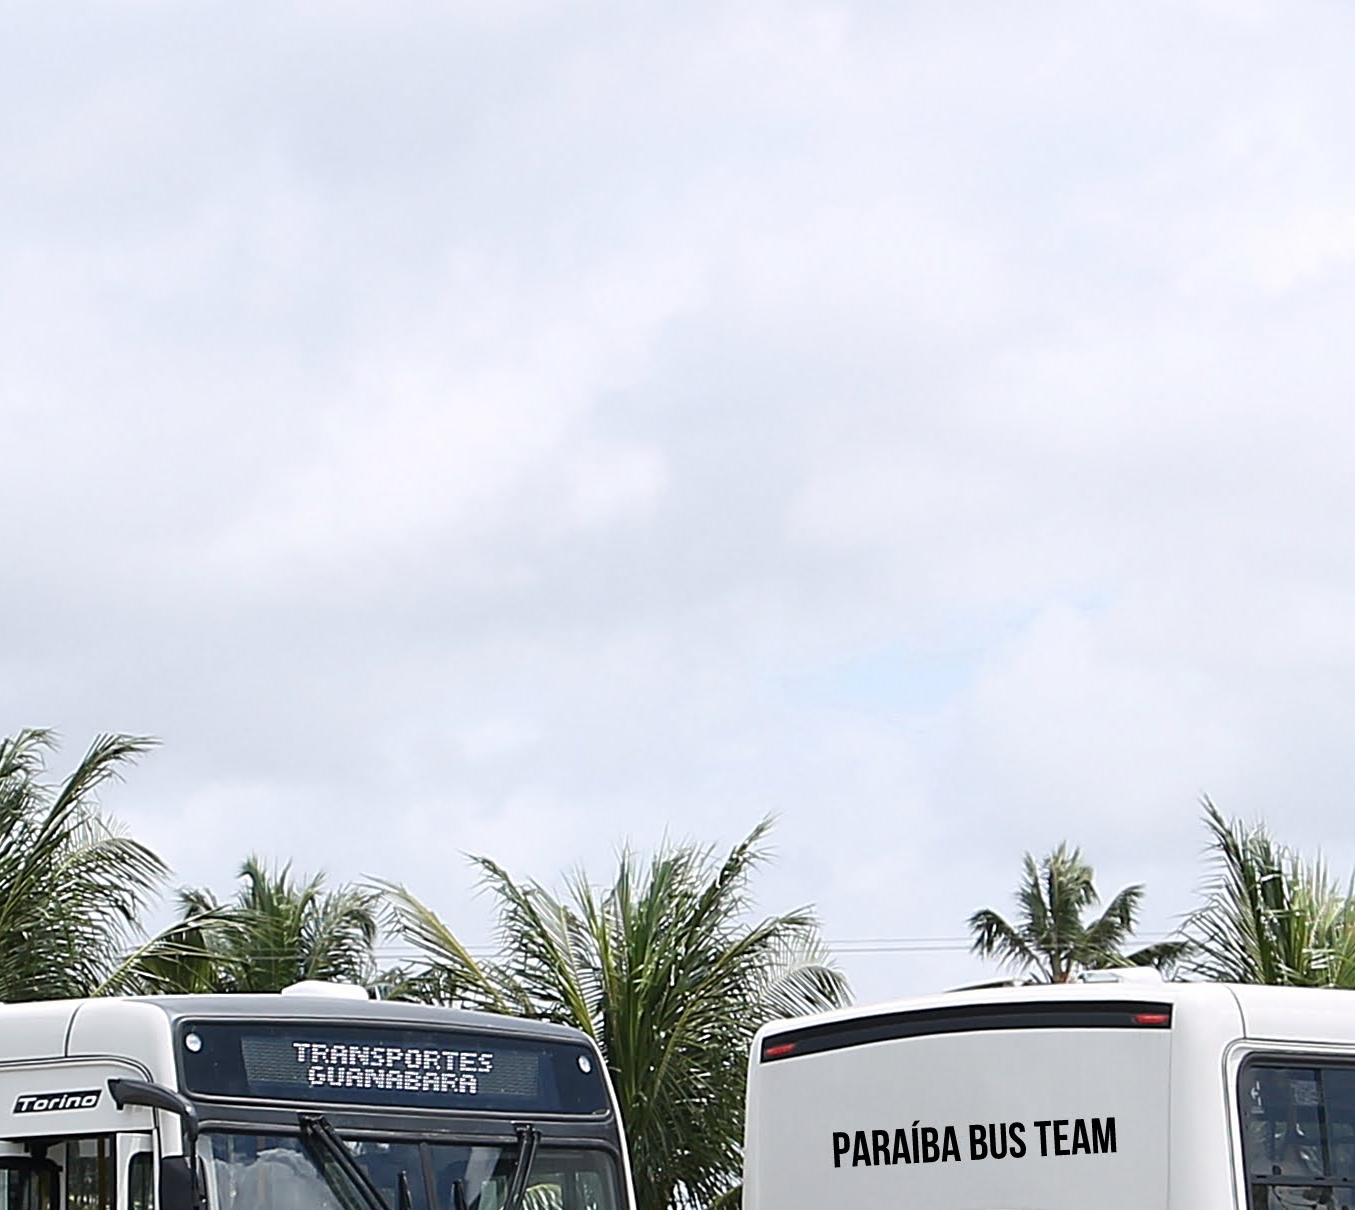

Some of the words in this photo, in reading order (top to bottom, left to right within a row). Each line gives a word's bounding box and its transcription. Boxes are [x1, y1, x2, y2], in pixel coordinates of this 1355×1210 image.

[292, 1042, 493, 1073] TRANSPORTES
[308, 1065, 477, 1094] GUANABARA
[18, 1094, 99, 1112] Torino
[832, 1120, 961, 1168] PARAÍBA
[968, 1121, 1027, 1161] BUS
[1033, 1116, 1118, 1157] TEAM
